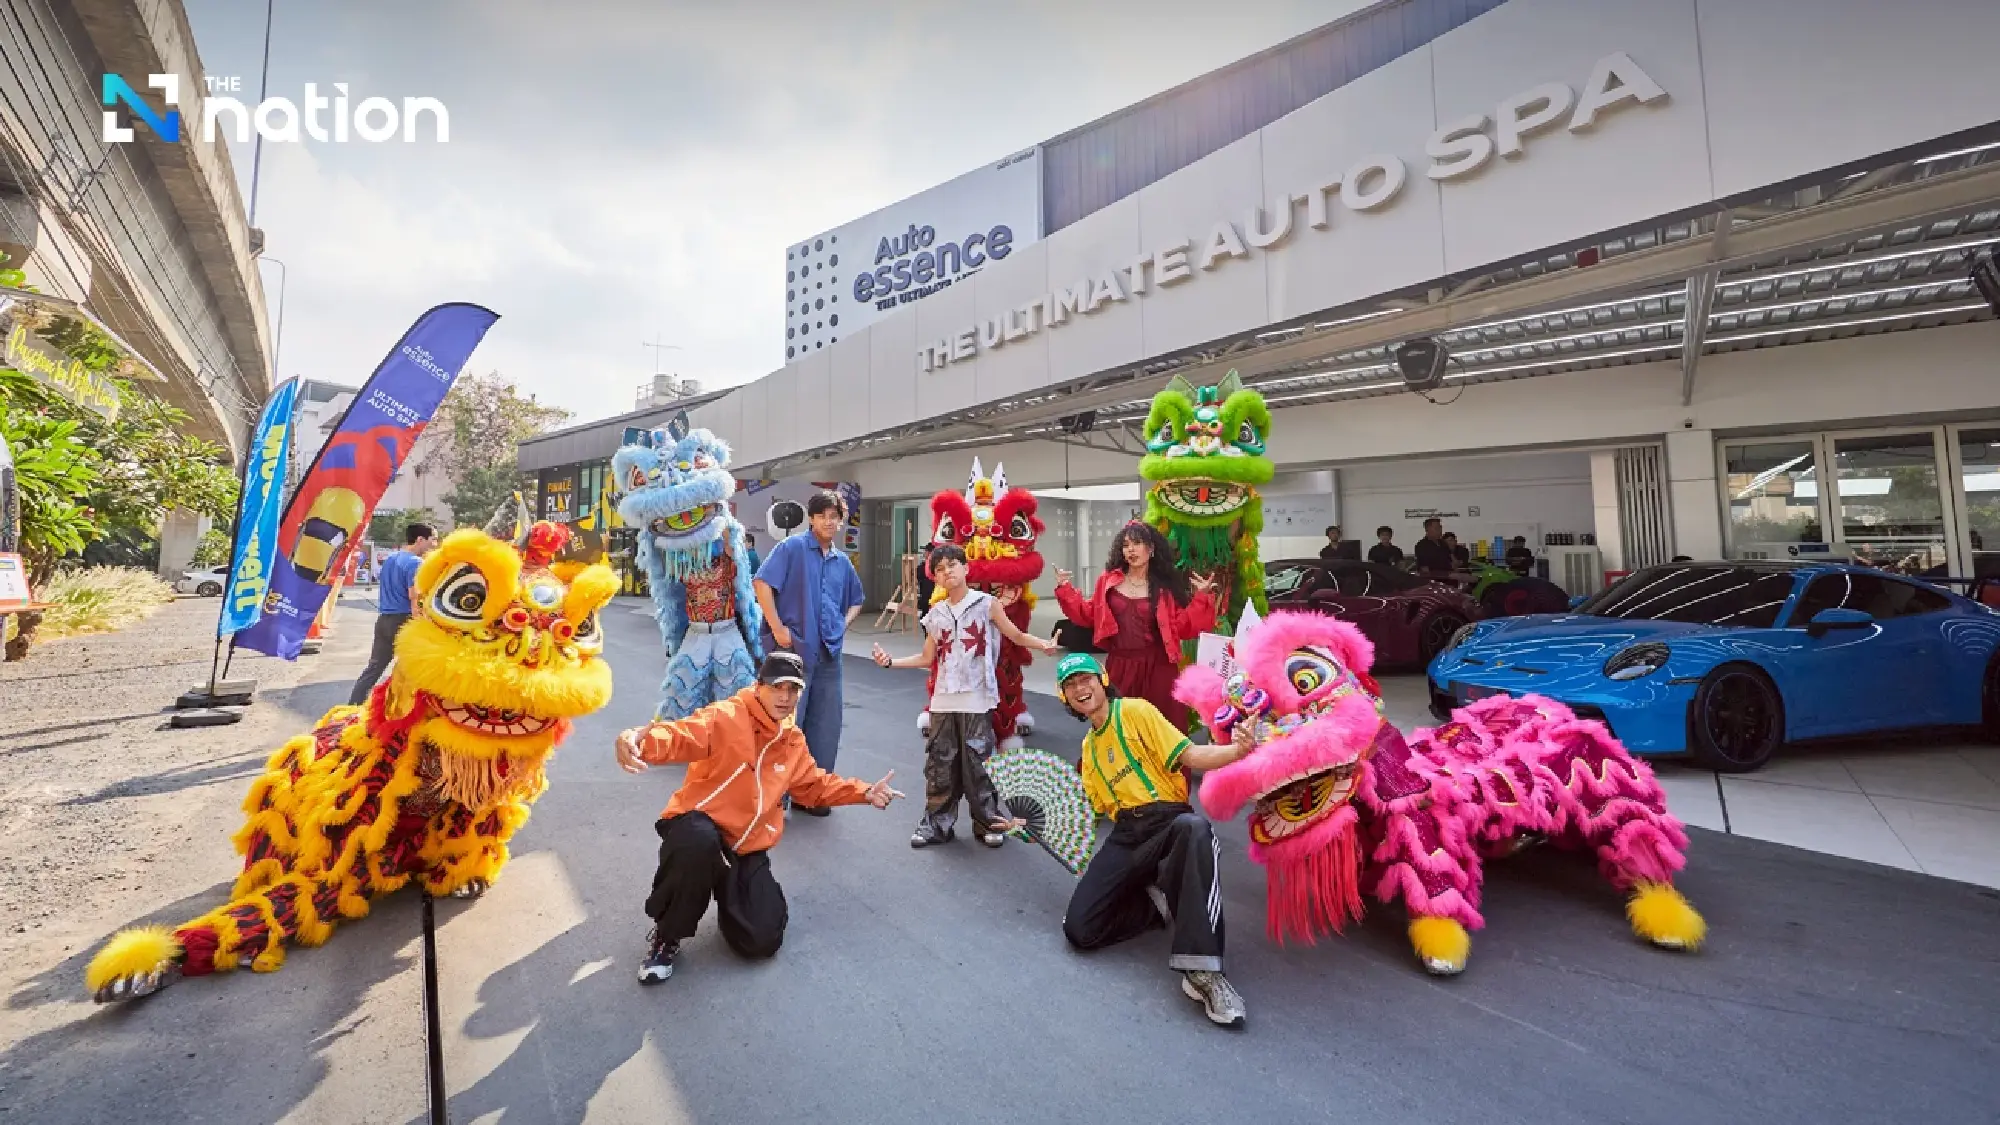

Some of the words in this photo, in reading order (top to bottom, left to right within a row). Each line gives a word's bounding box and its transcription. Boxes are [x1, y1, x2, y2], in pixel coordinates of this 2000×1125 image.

[918, 326, 977, 372] THE
[979, 236, 1192, 349] ULTIMATE
[1200, 154, 1407, 271] AUTO
[1425, 51, 1672, 182] SPA
[874, 223, 935, 265] Auto
[853, 224, 1014, 303] essence
[402, 345, 450, 381] essence
[366, 397, 396, 417] AUTO
[396, 413, 416, 429] SPA
[373, 388, 420, 421] ULTIMATE
[546, 494, 572, 513] PLAY
